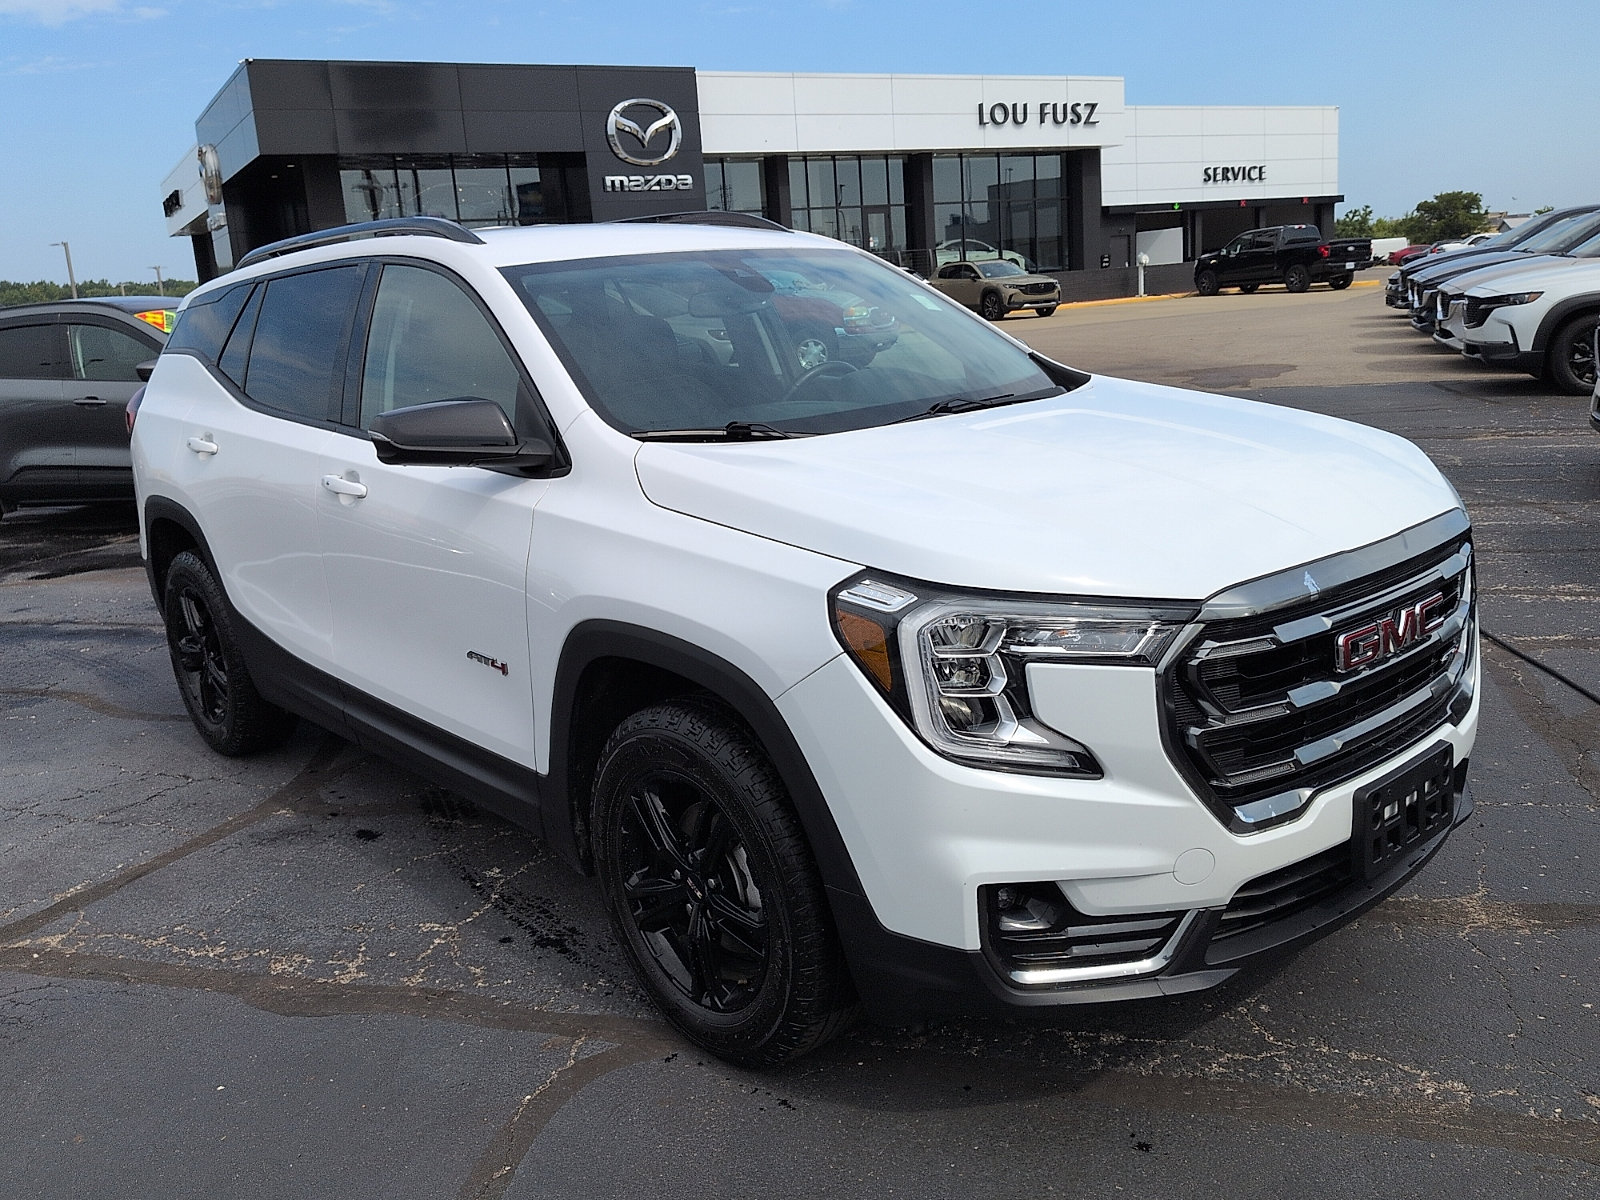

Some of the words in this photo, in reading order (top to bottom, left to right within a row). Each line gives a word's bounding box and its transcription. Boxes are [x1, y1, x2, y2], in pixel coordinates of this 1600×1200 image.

[977, 101, 1028, 126] LOU
[1039, 101, 1100, 126] FUSZ
[1203, 164, 1266, 182] SERVICE
[1335, 592, 1444, 673] GMC
[466, 650, 509, 677] AT4
